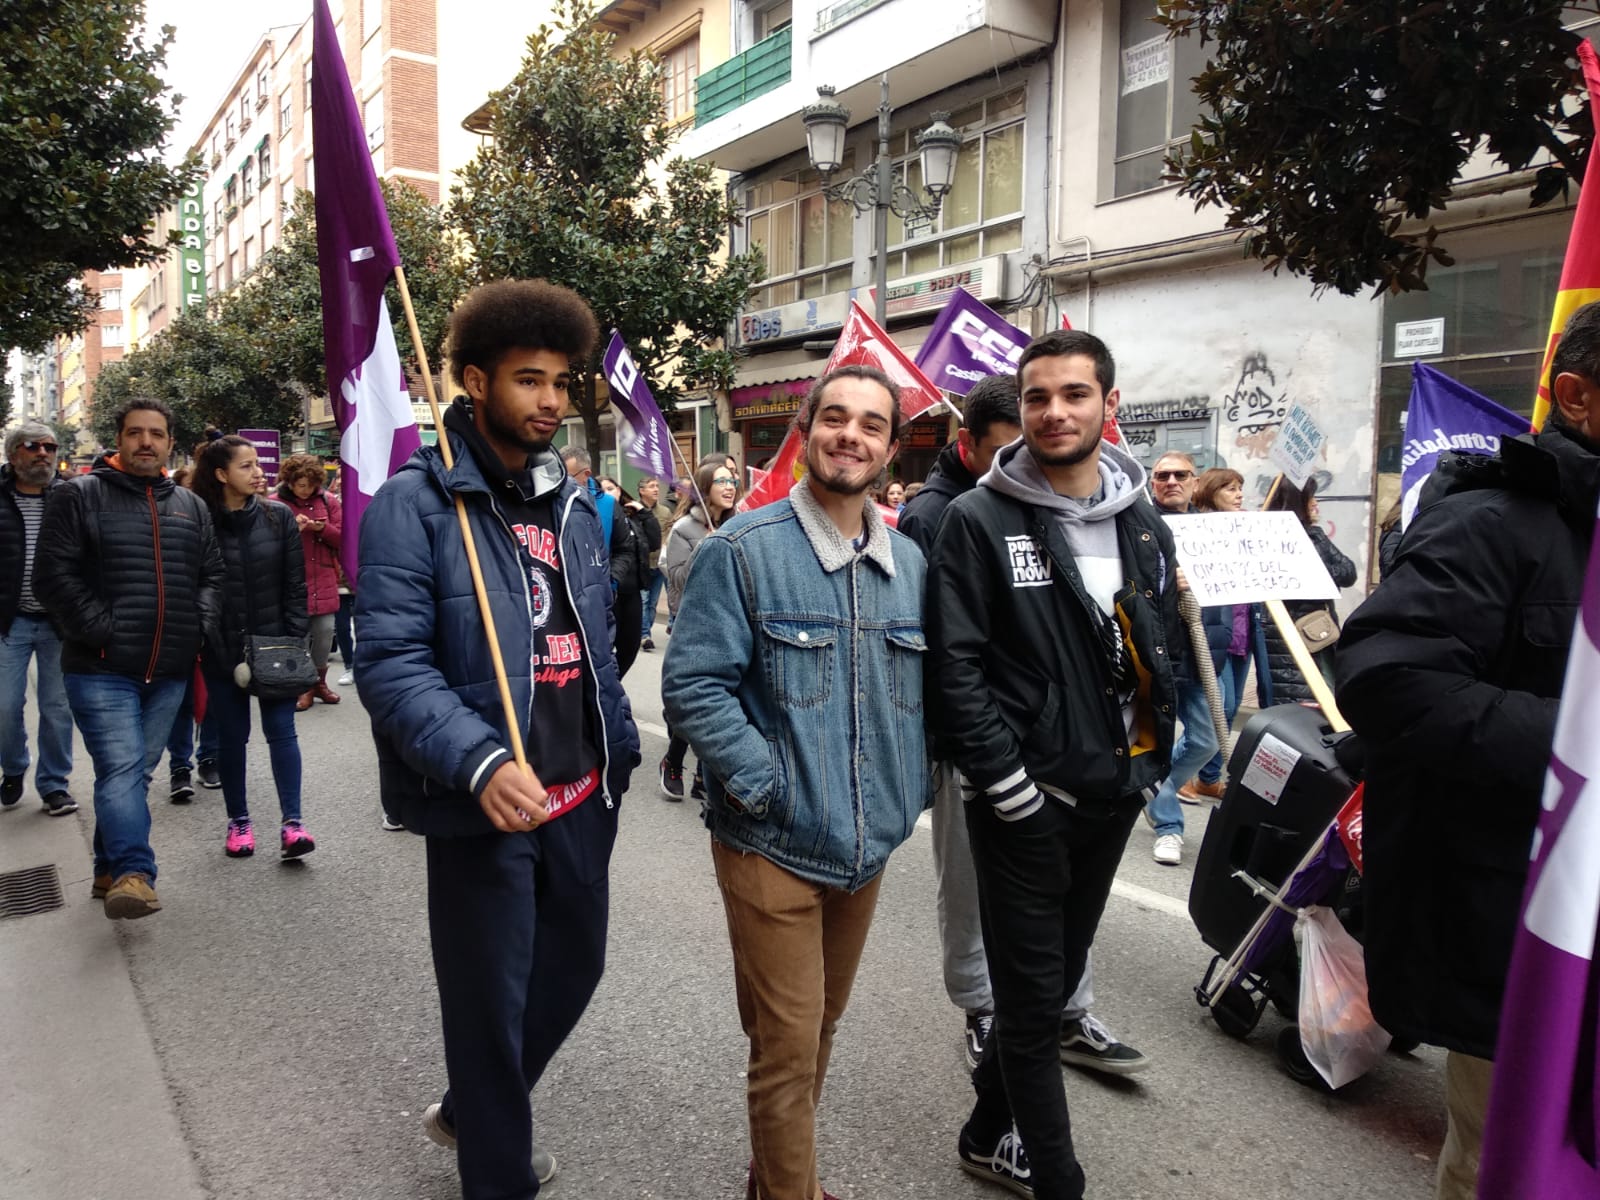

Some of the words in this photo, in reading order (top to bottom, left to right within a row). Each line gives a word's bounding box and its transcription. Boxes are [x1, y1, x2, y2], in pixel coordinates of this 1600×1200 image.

[1012, 565, 1052, 582] now
[1258, 560, 1289, 574] DEL
[534, 666, 582, 688] ollege
